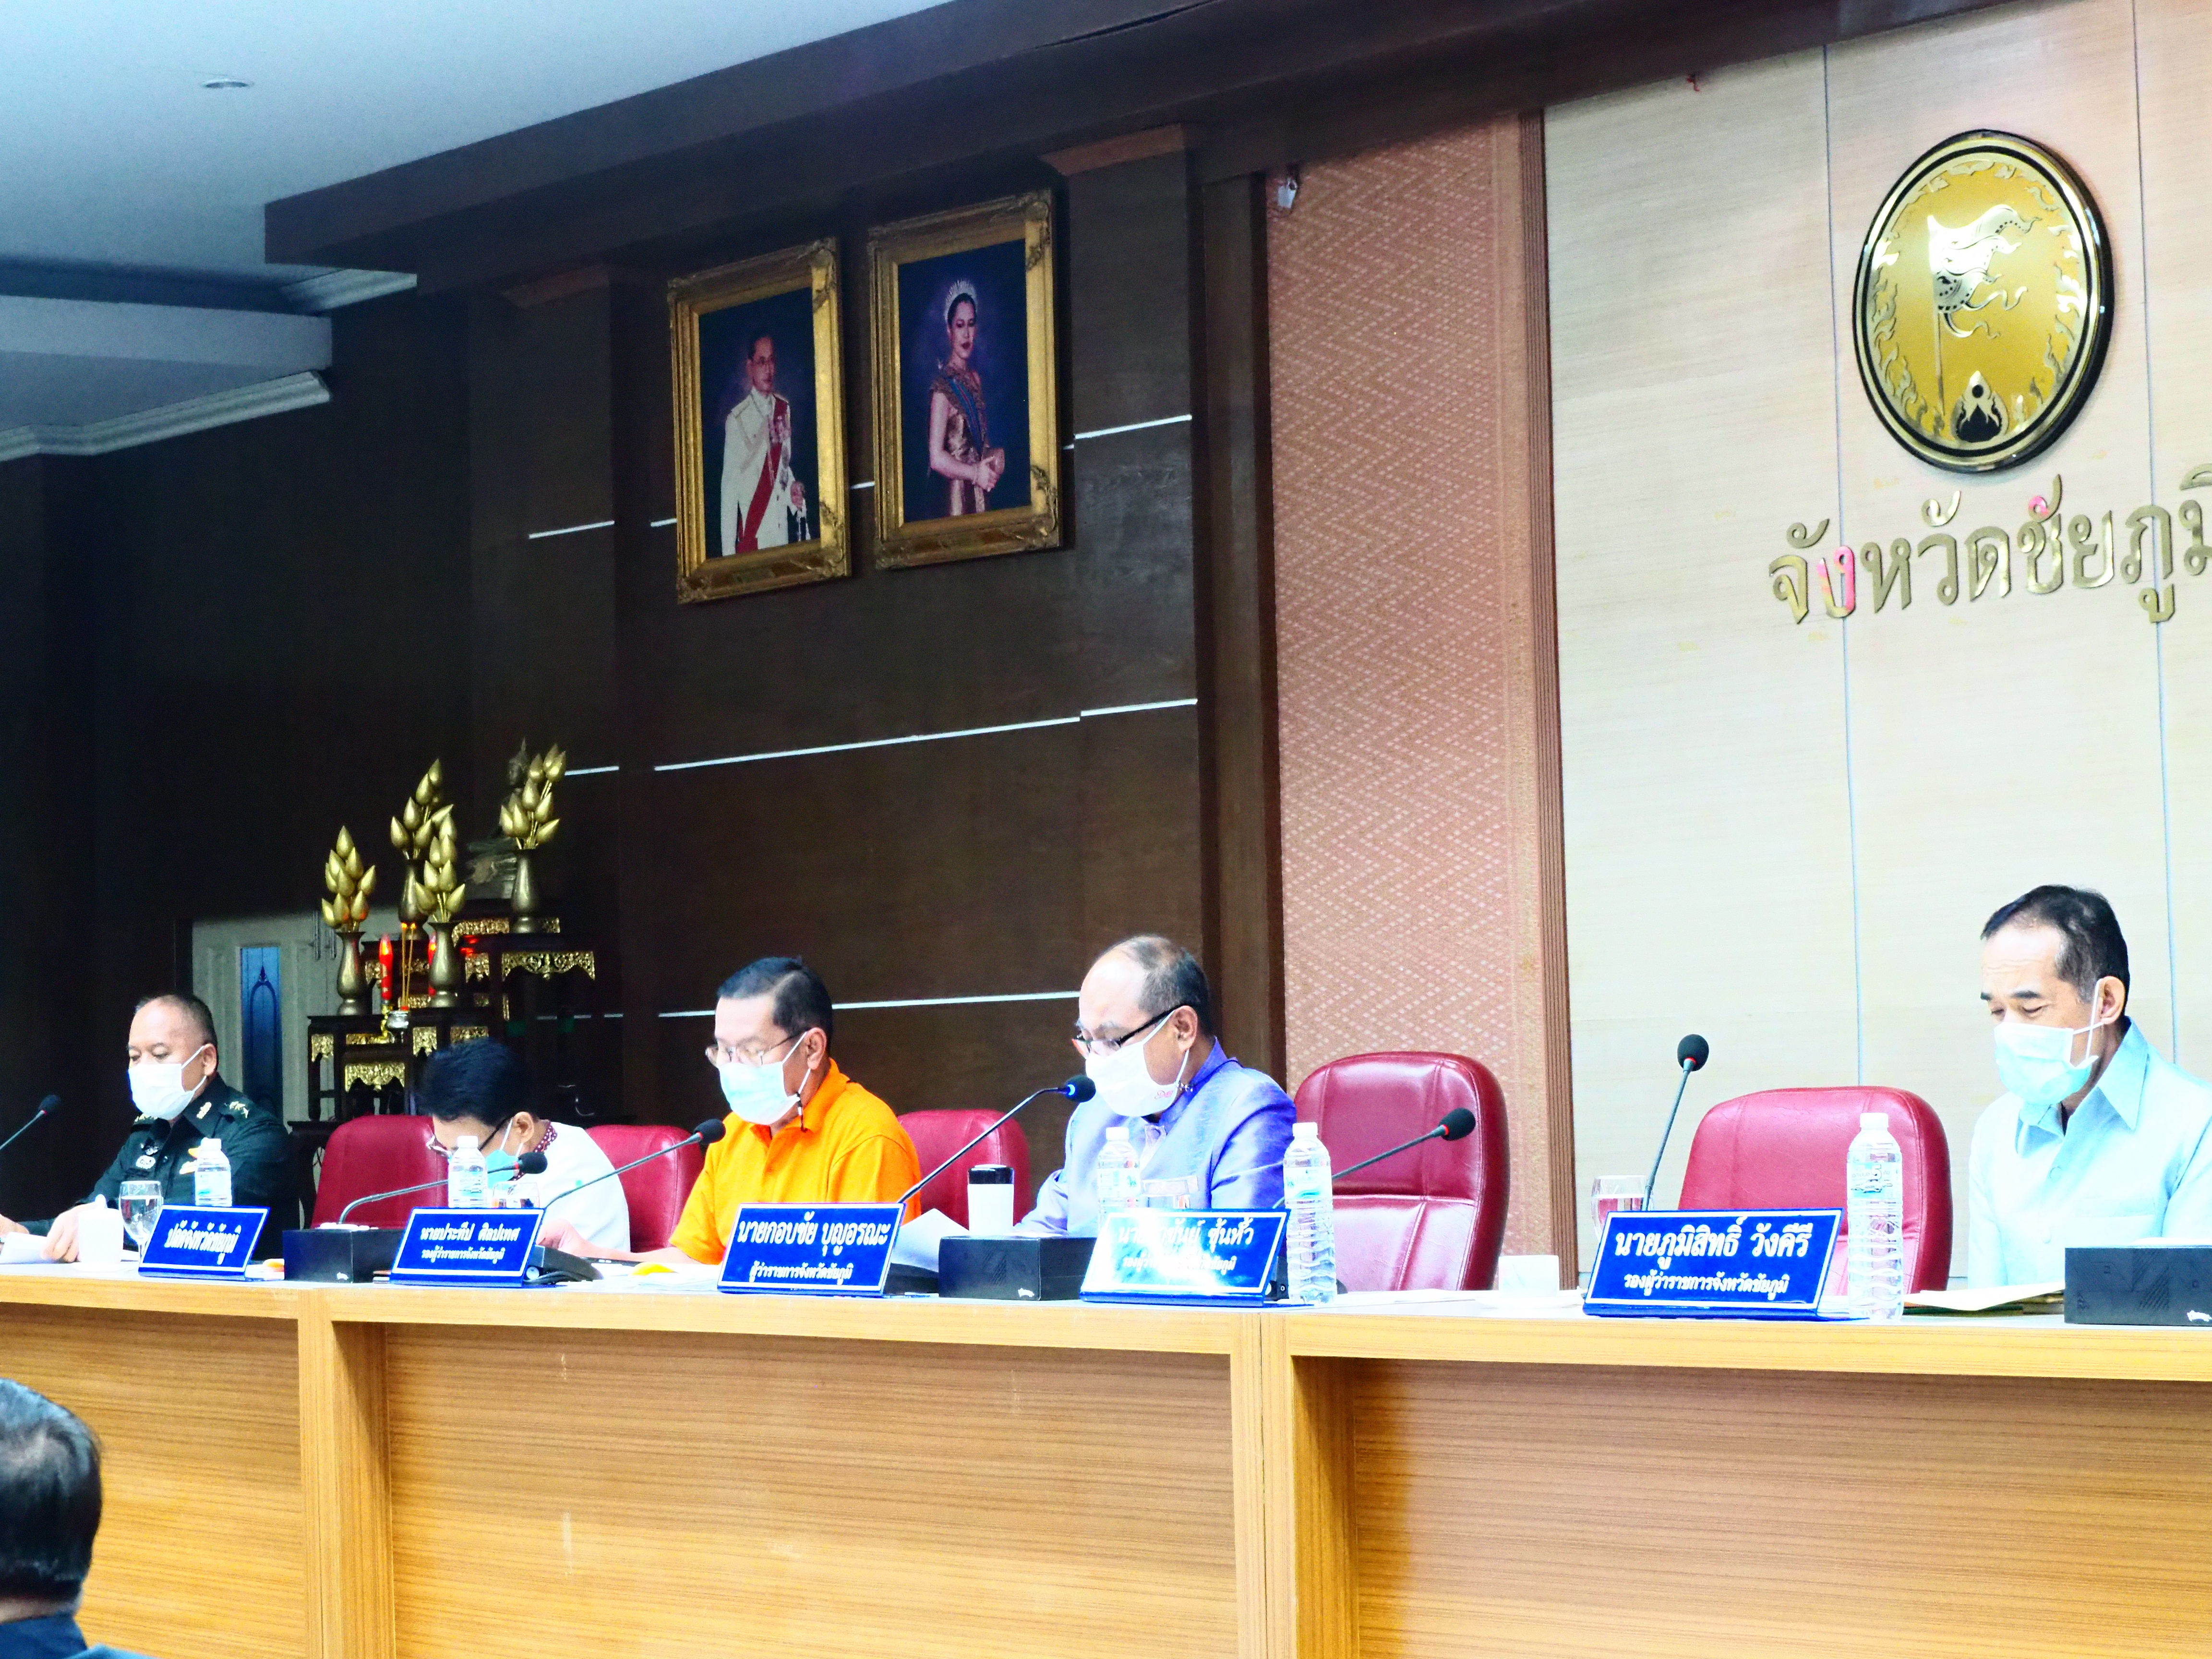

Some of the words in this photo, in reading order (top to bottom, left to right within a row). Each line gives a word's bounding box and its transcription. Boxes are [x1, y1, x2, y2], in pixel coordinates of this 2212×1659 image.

[421, 1221, 475, 1241] นายประทีป
[737, 1211, 818, 1244] นายกอบชัย
[821, 1223, 891, 1257] บุญอรณะ
[1615, 1216, 1747, 1269] นายภูมิสิทธิ์
[1751, 1223, 1813, 1257] วังคีรี
[749, 1260, 854, 1285] ผู้ว่าราชการจังหวัดชัยภูมิ
[1624, 1269, 1790, 1300] รองผู้ว่าราชการจังหวัดชัยภูมิ
